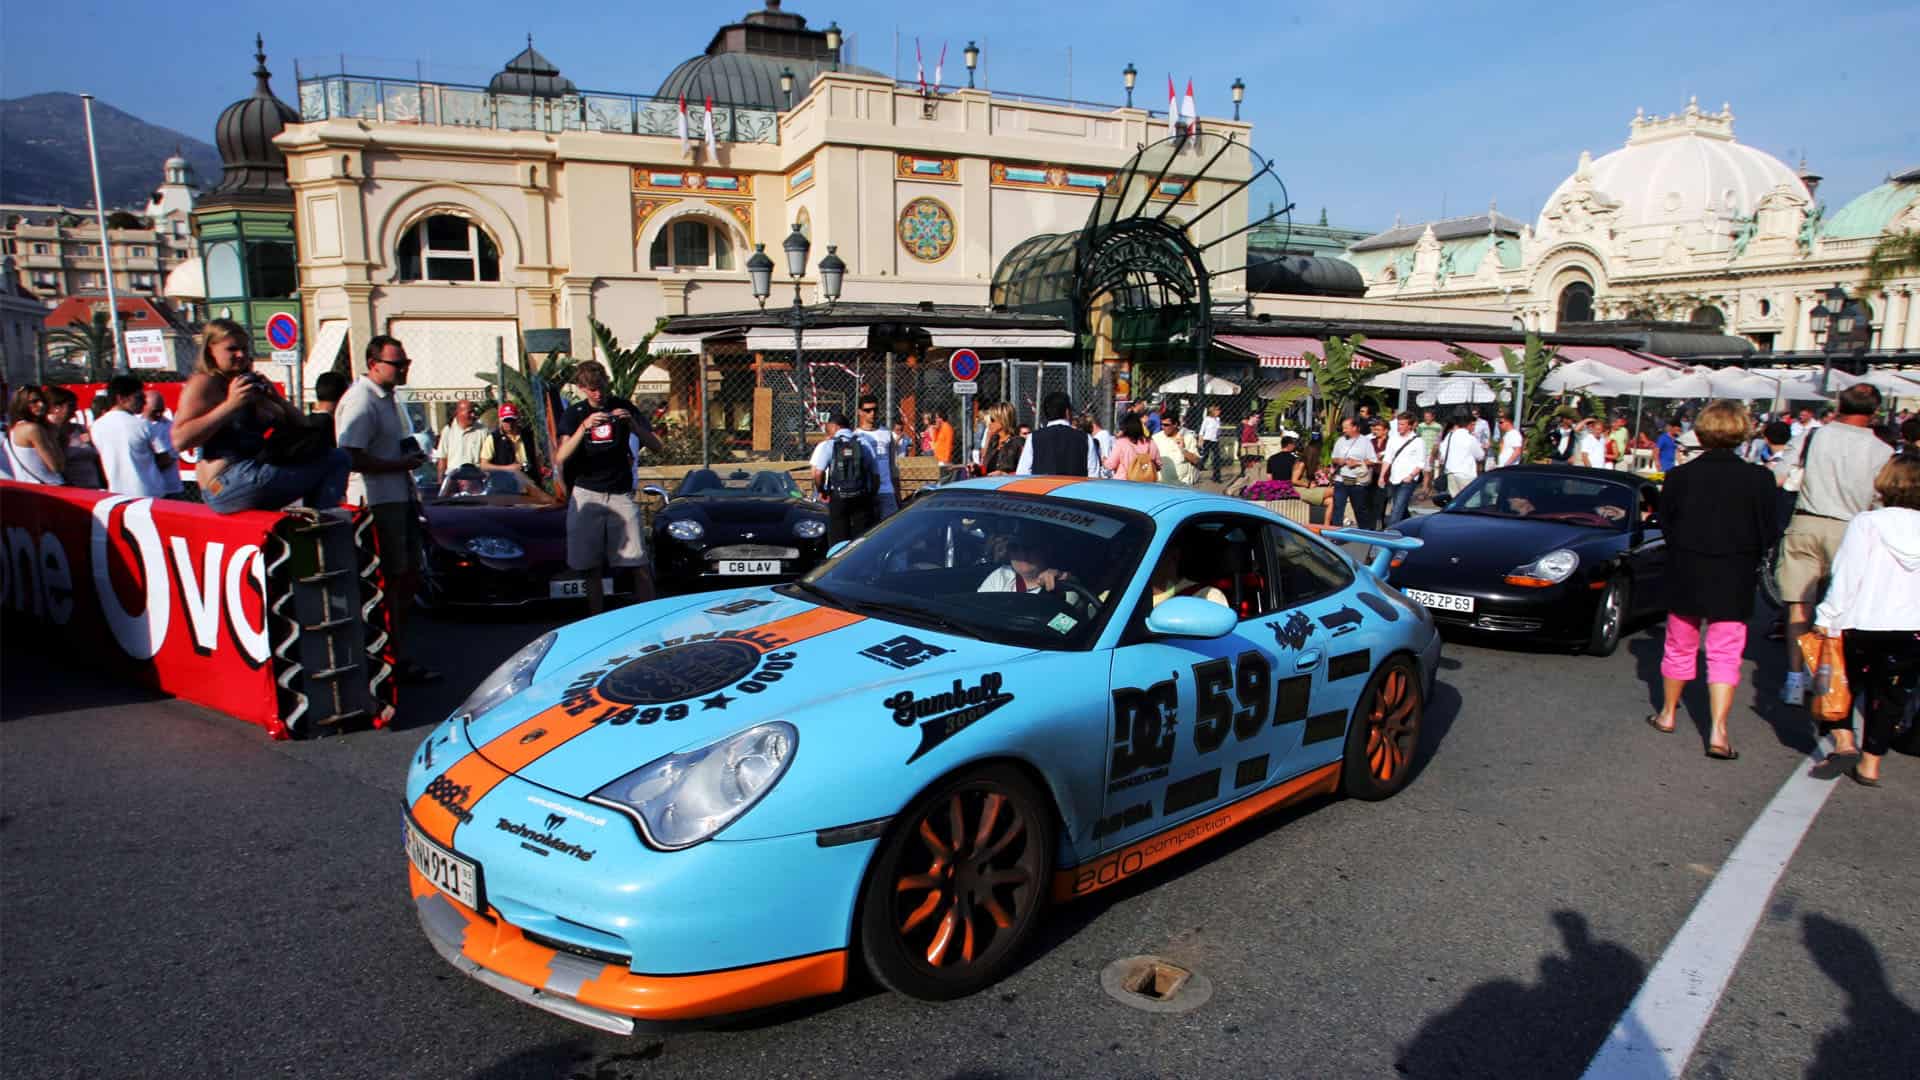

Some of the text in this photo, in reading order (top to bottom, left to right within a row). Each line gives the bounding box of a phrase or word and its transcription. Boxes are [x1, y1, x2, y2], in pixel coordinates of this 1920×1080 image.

[407, 390, 443, 401] ZEGG
[747, 562, 771, 573] LAV
[1408, 590, 1470, 611] 7626 ZP 69
[883, 671, 1003, 728] Gumball
[1191, 649, 1272, 755] 59
[432, 851, 461, 897] 911
[1073, 846, 1143, 894] edo
[1143, 814, 1233, 860] competition
